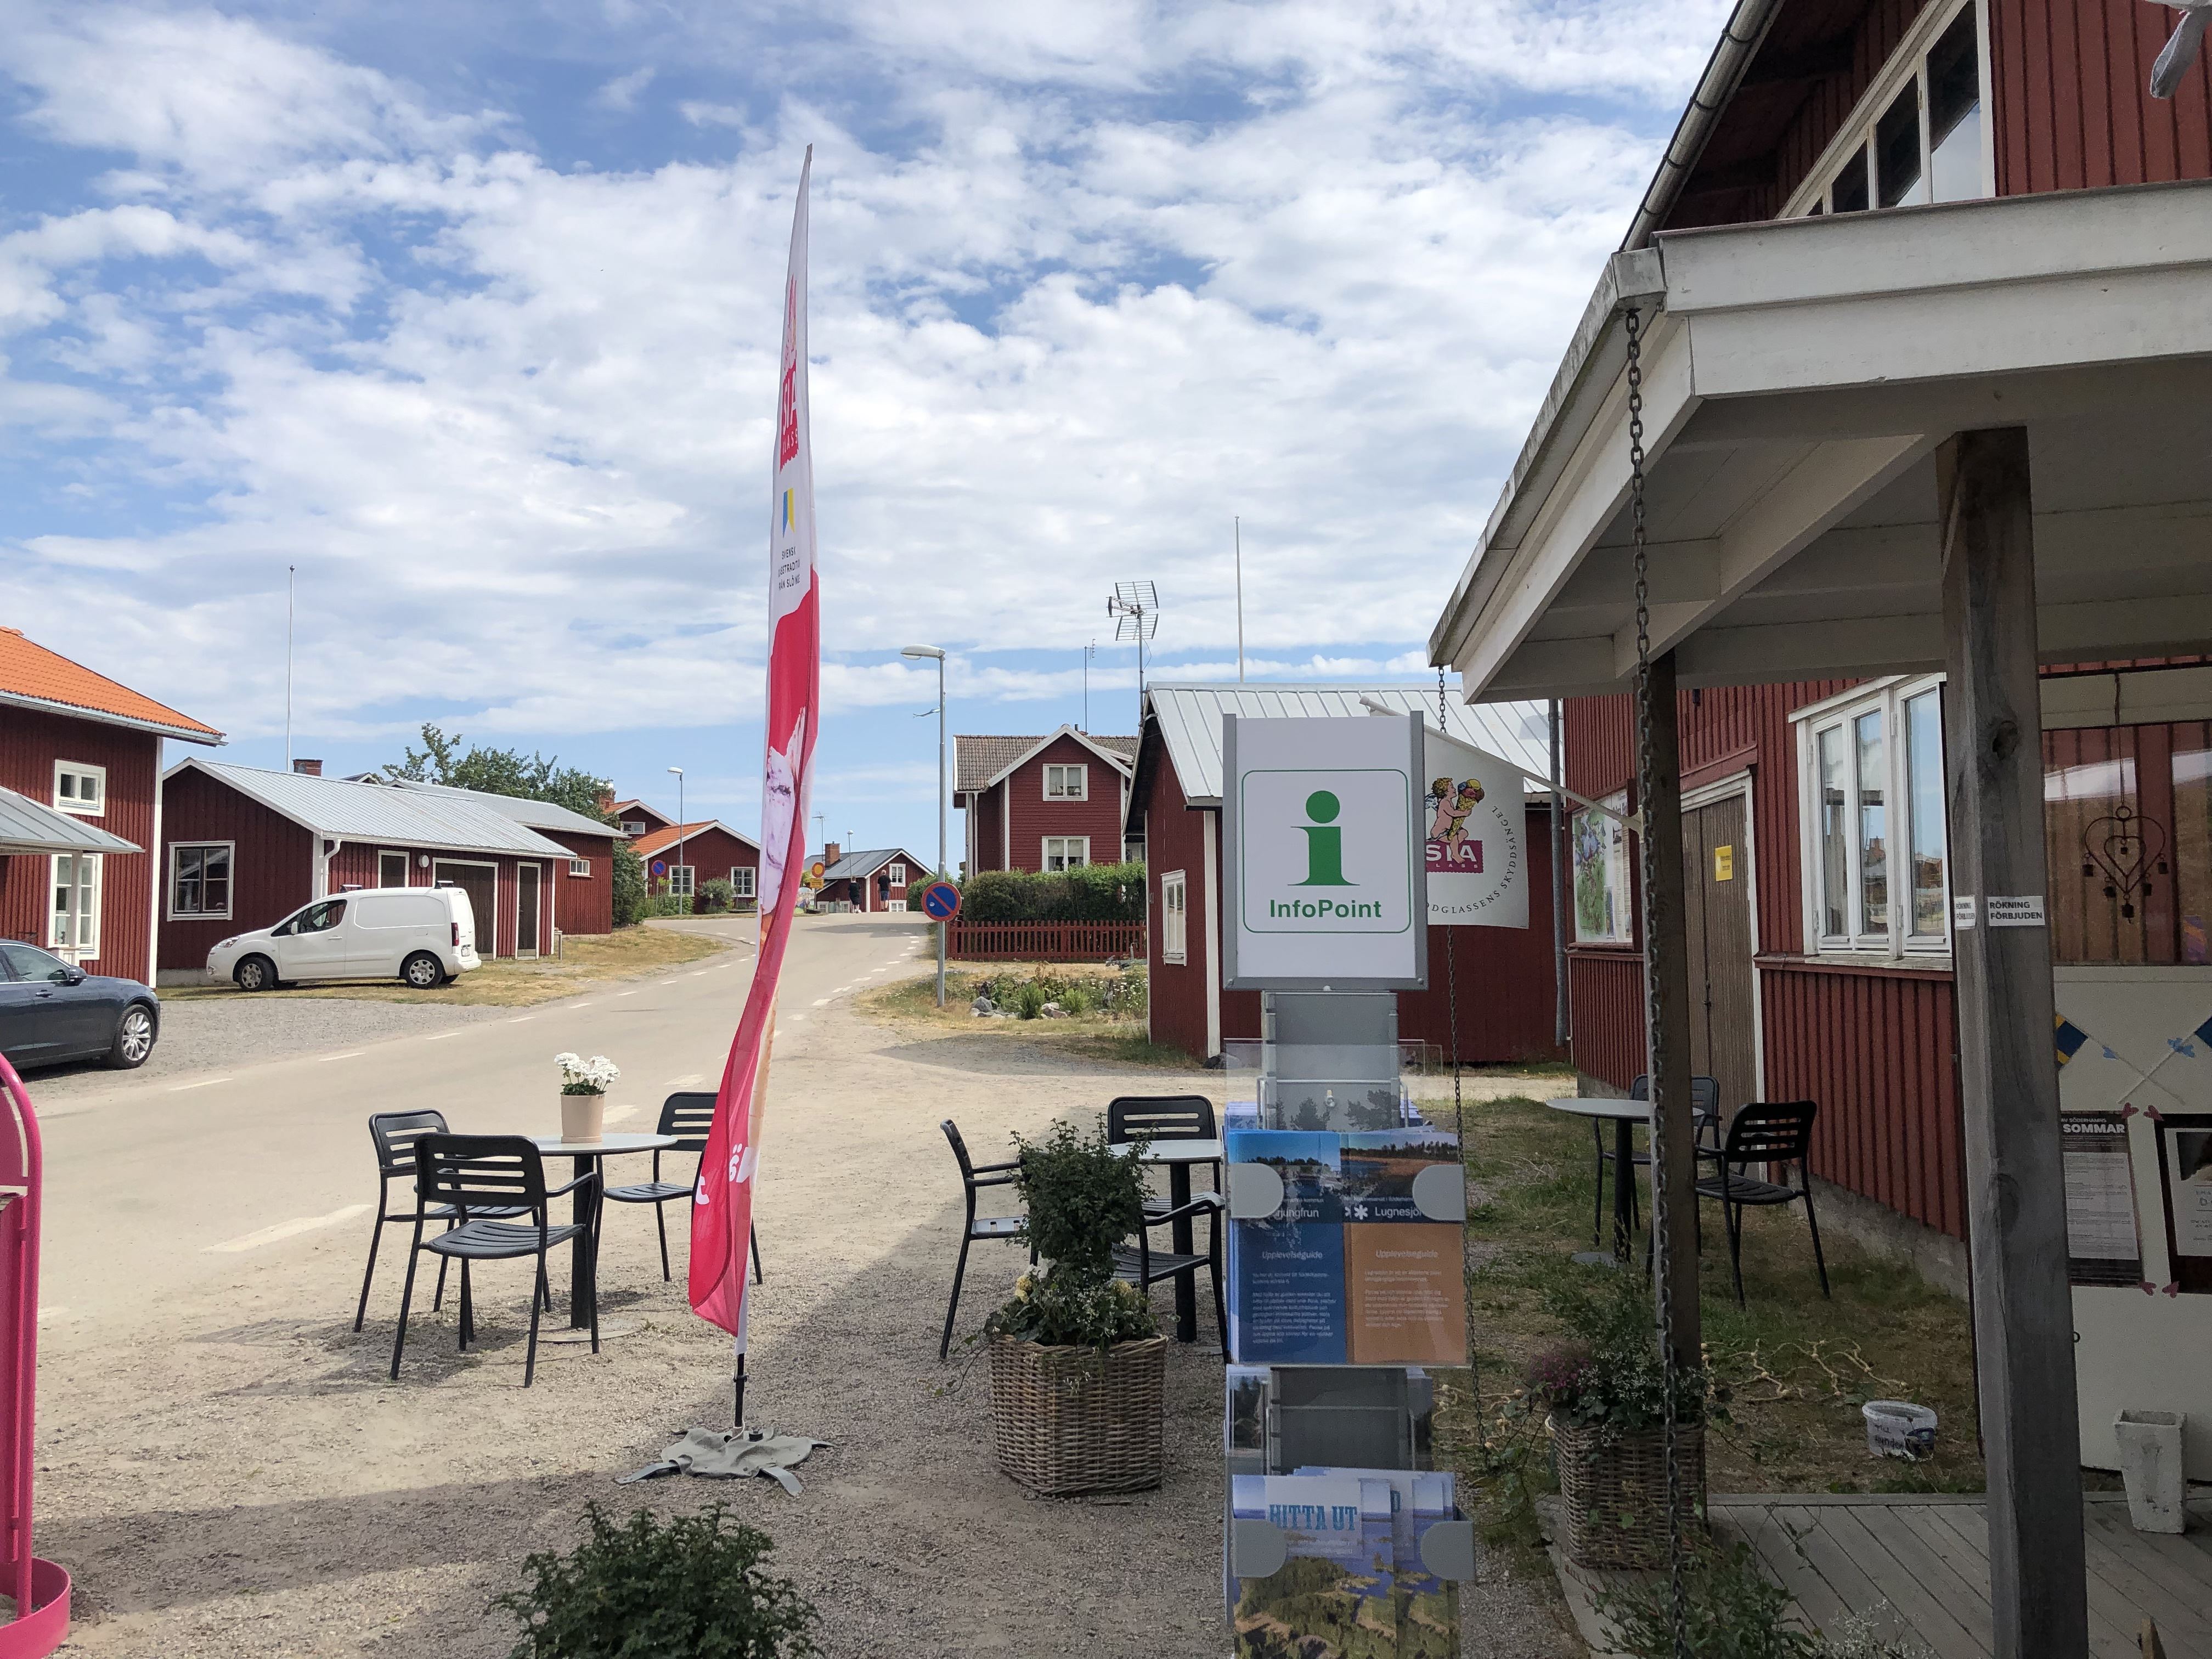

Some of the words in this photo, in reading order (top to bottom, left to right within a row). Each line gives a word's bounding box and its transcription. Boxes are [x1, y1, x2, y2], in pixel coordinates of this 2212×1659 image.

[1492, 805, 1517, 889] SKYDDSÄNGEL
[1270, 899, 1382, 918] InfoPoint
[1989, 901, 2030, 909] RÖKNING
[1990, 912, 2043, 920] FÖRBJUDEN
[2063, 1124, 2125, 1133] SOMMAR
[1269, 1504, 1328, 1530] HITTA
[1331, 1505, 1358, 1531] UT
